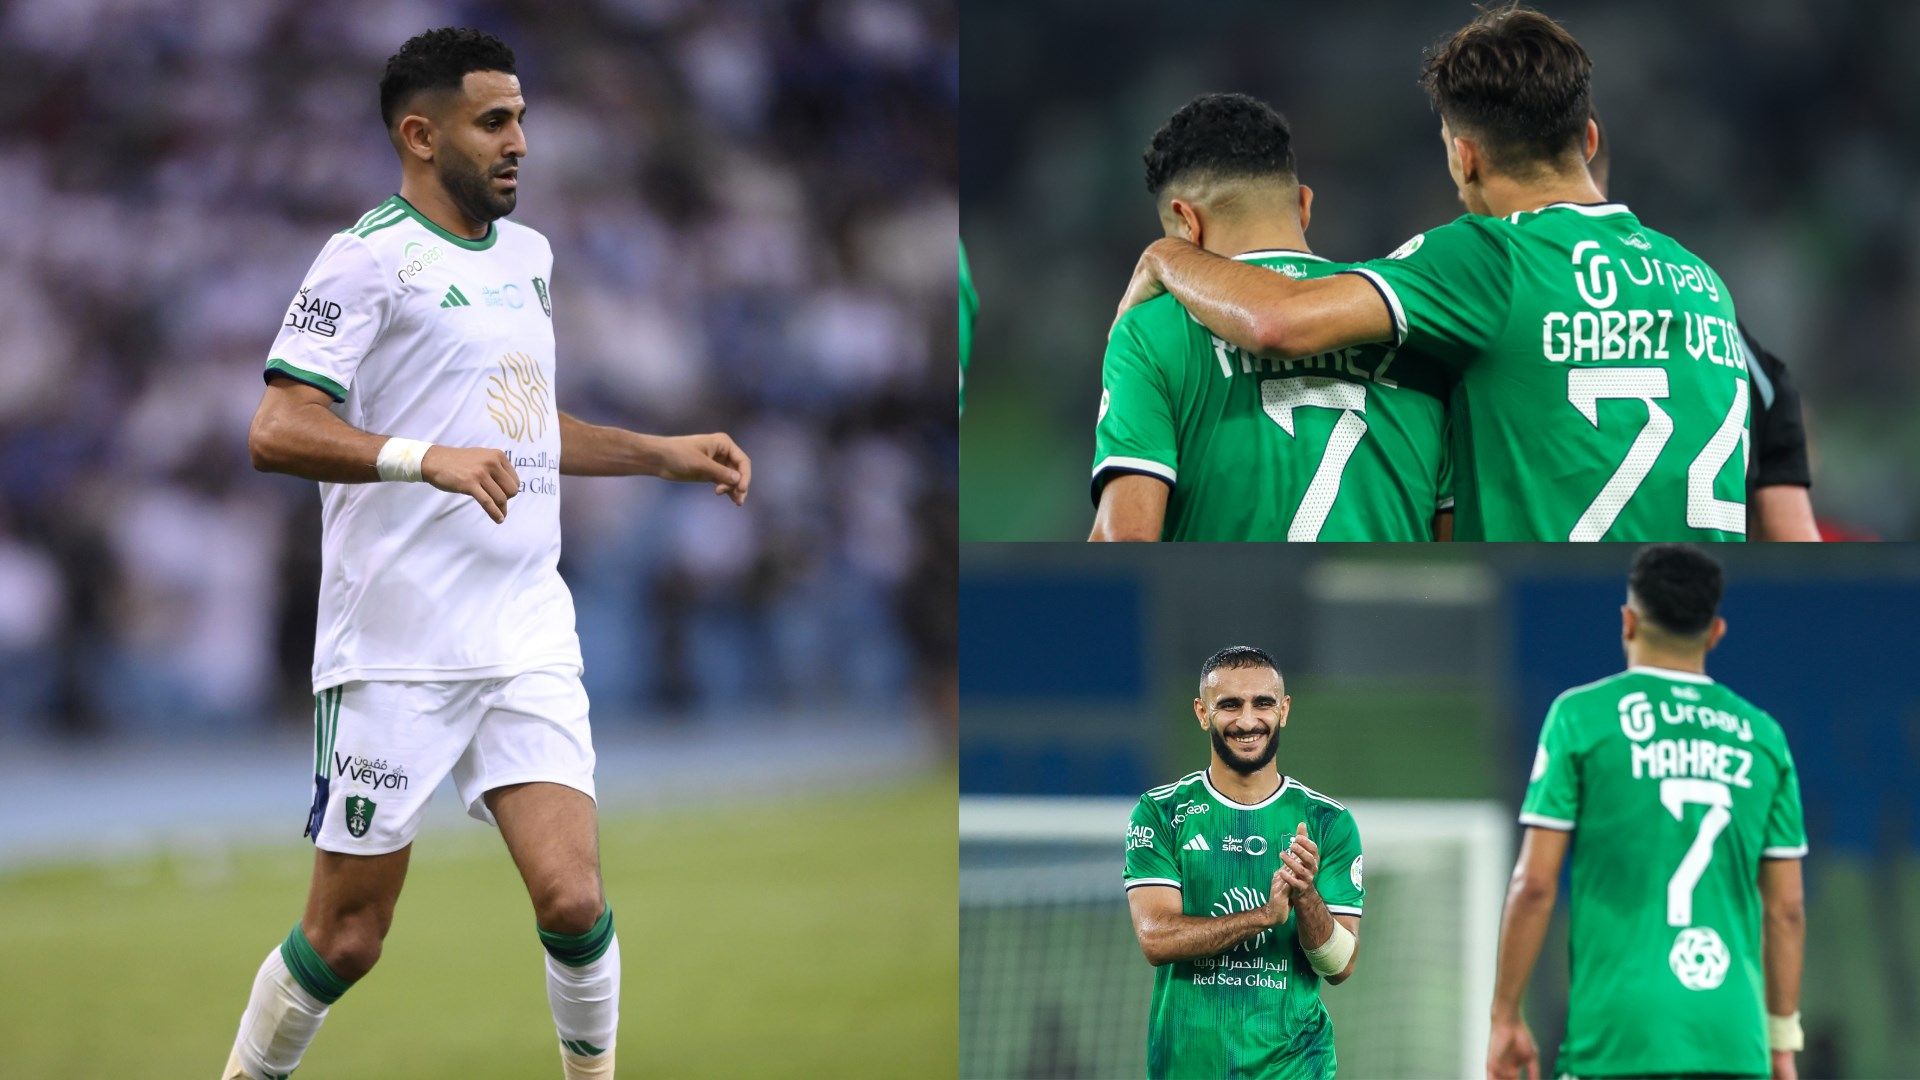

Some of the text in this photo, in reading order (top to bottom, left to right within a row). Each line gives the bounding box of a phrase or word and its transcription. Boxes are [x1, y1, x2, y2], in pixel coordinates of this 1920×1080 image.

[1619, 256, 1720, 303] urpay
[294, 294, 342, 320] QAID
[1542, 309, 1748, 375] GABRI VEIG
[1261, 375, 1369, 542] 7
[1631, 739, 1753, 789] MAHREZ
[1222, 843, 1243, 853] SIRC
[1660, 778, 1733, 926] 7
[1193, 972, 1287, 990] Red Sea Global
[1263, 959, 1288, 973] البحر
